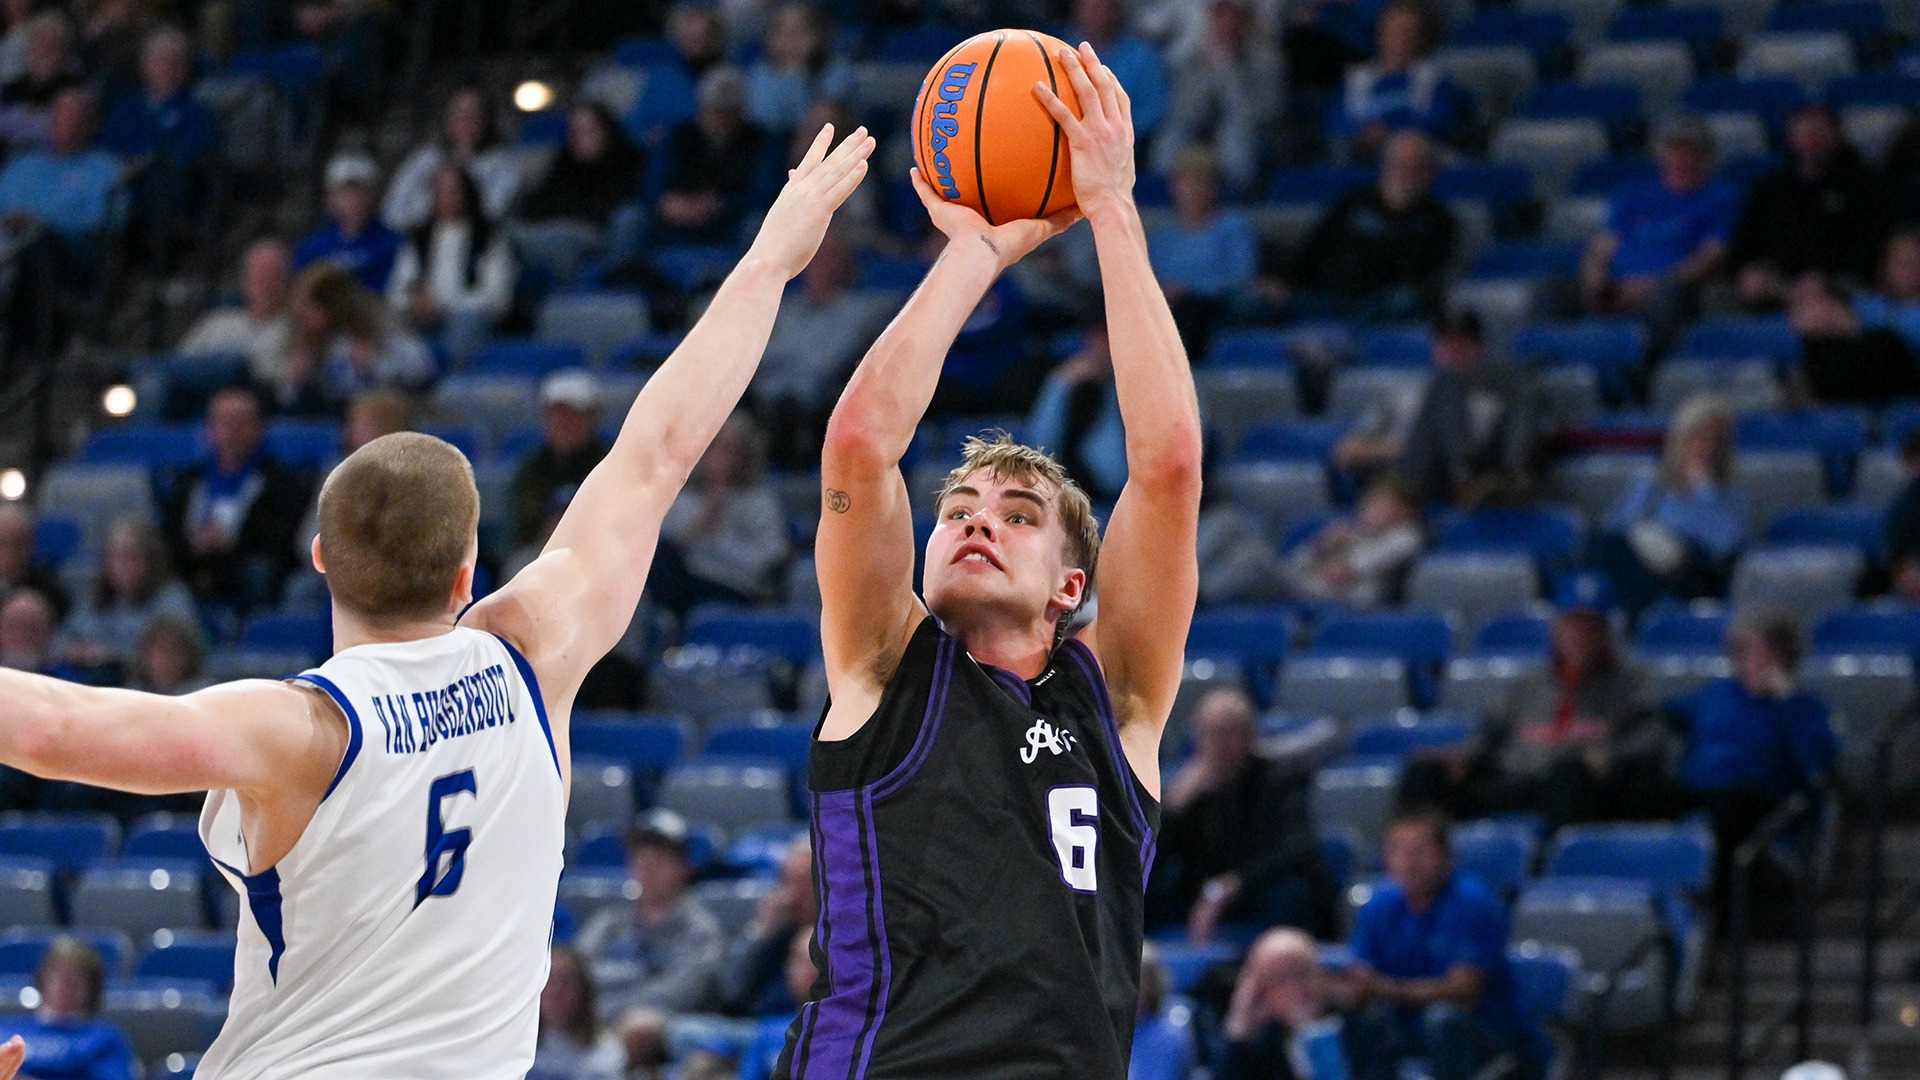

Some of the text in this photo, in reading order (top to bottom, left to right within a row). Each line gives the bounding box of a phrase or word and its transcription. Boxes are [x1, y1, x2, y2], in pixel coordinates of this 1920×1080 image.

[931, 62, 977, 198] Wilson
[371, 695, 416, 754] VAN
[412, 766, 478, 911] 6
[1046, 784, 1098, 895] 6
